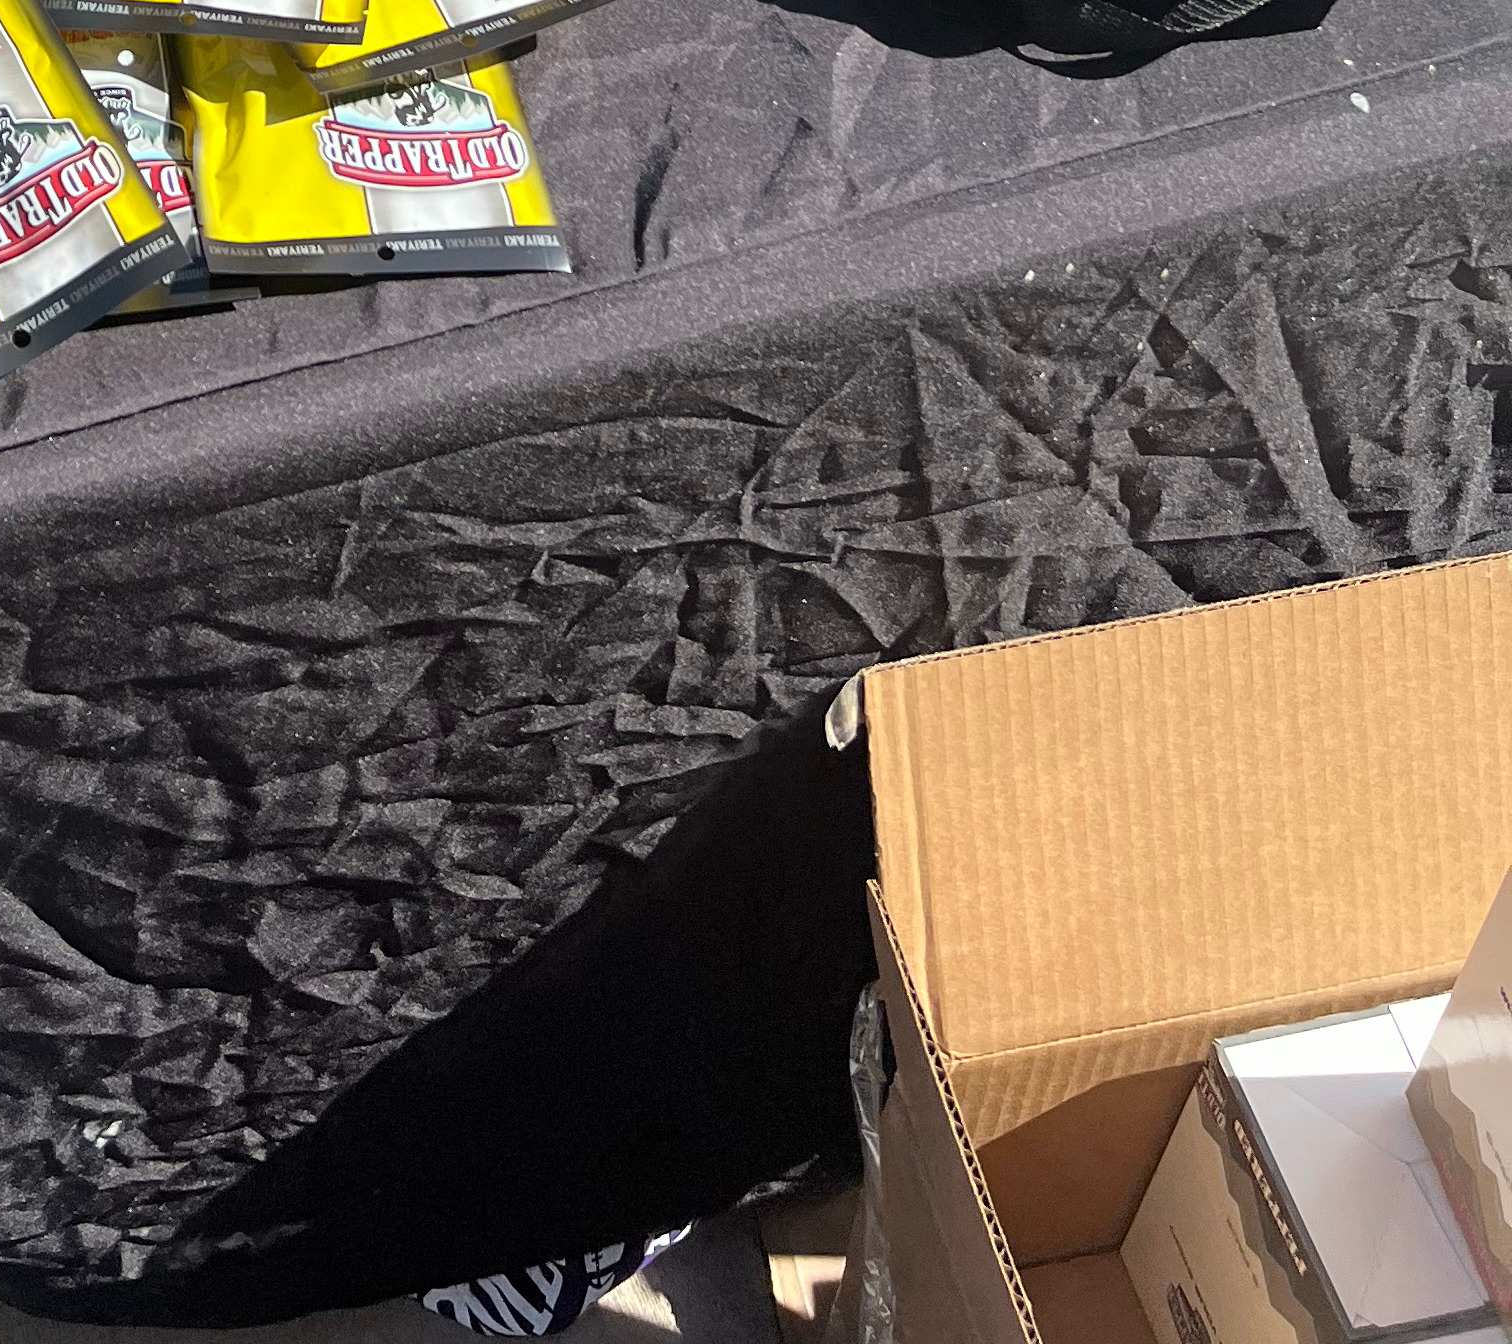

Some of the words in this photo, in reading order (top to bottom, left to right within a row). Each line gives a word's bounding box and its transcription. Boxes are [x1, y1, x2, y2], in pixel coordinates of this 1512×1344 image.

[76, 0, 130, 15] TERIYAKI
[304, 23, 360, 35] TERIYAKI
[361, 47, 414, 69] TERIYAKI
[315, 126, 473, 181] TRAPPER
[466, 130, 524, 170] OLD
[59, 149, 121, 186] OLD
[266, 244, 324, 257] TERIYAKI
[503, 233, 560, 247] TERIYAKI
[119, 233, 175, 271] TERIYAKI
